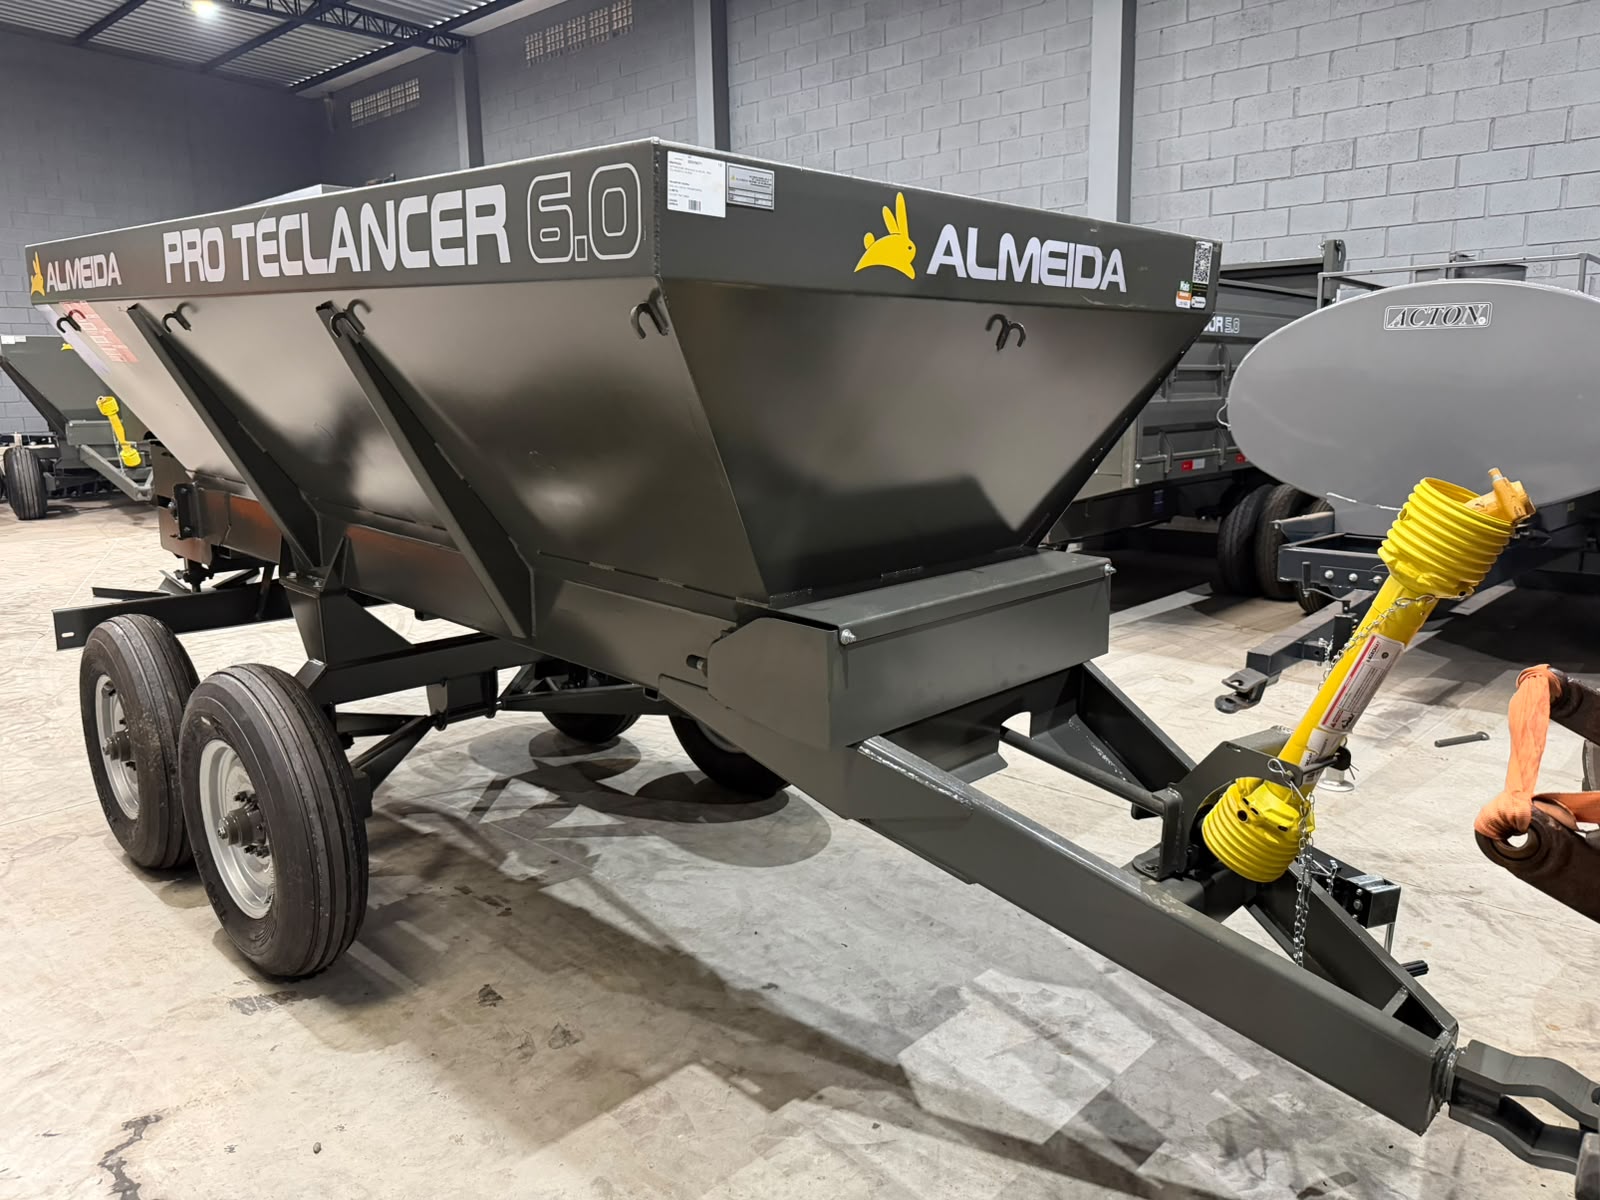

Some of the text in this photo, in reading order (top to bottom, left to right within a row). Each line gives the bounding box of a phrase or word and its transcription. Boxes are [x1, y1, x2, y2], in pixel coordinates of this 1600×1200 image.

[163, 162, 642, 283] PRO TECLANCER 6.0
[47, 252, 122, 293] ALMEIDA
[926, 223, 1127, 293] ALMEIDA
[1387, 304, 1485, 327] ACTON
